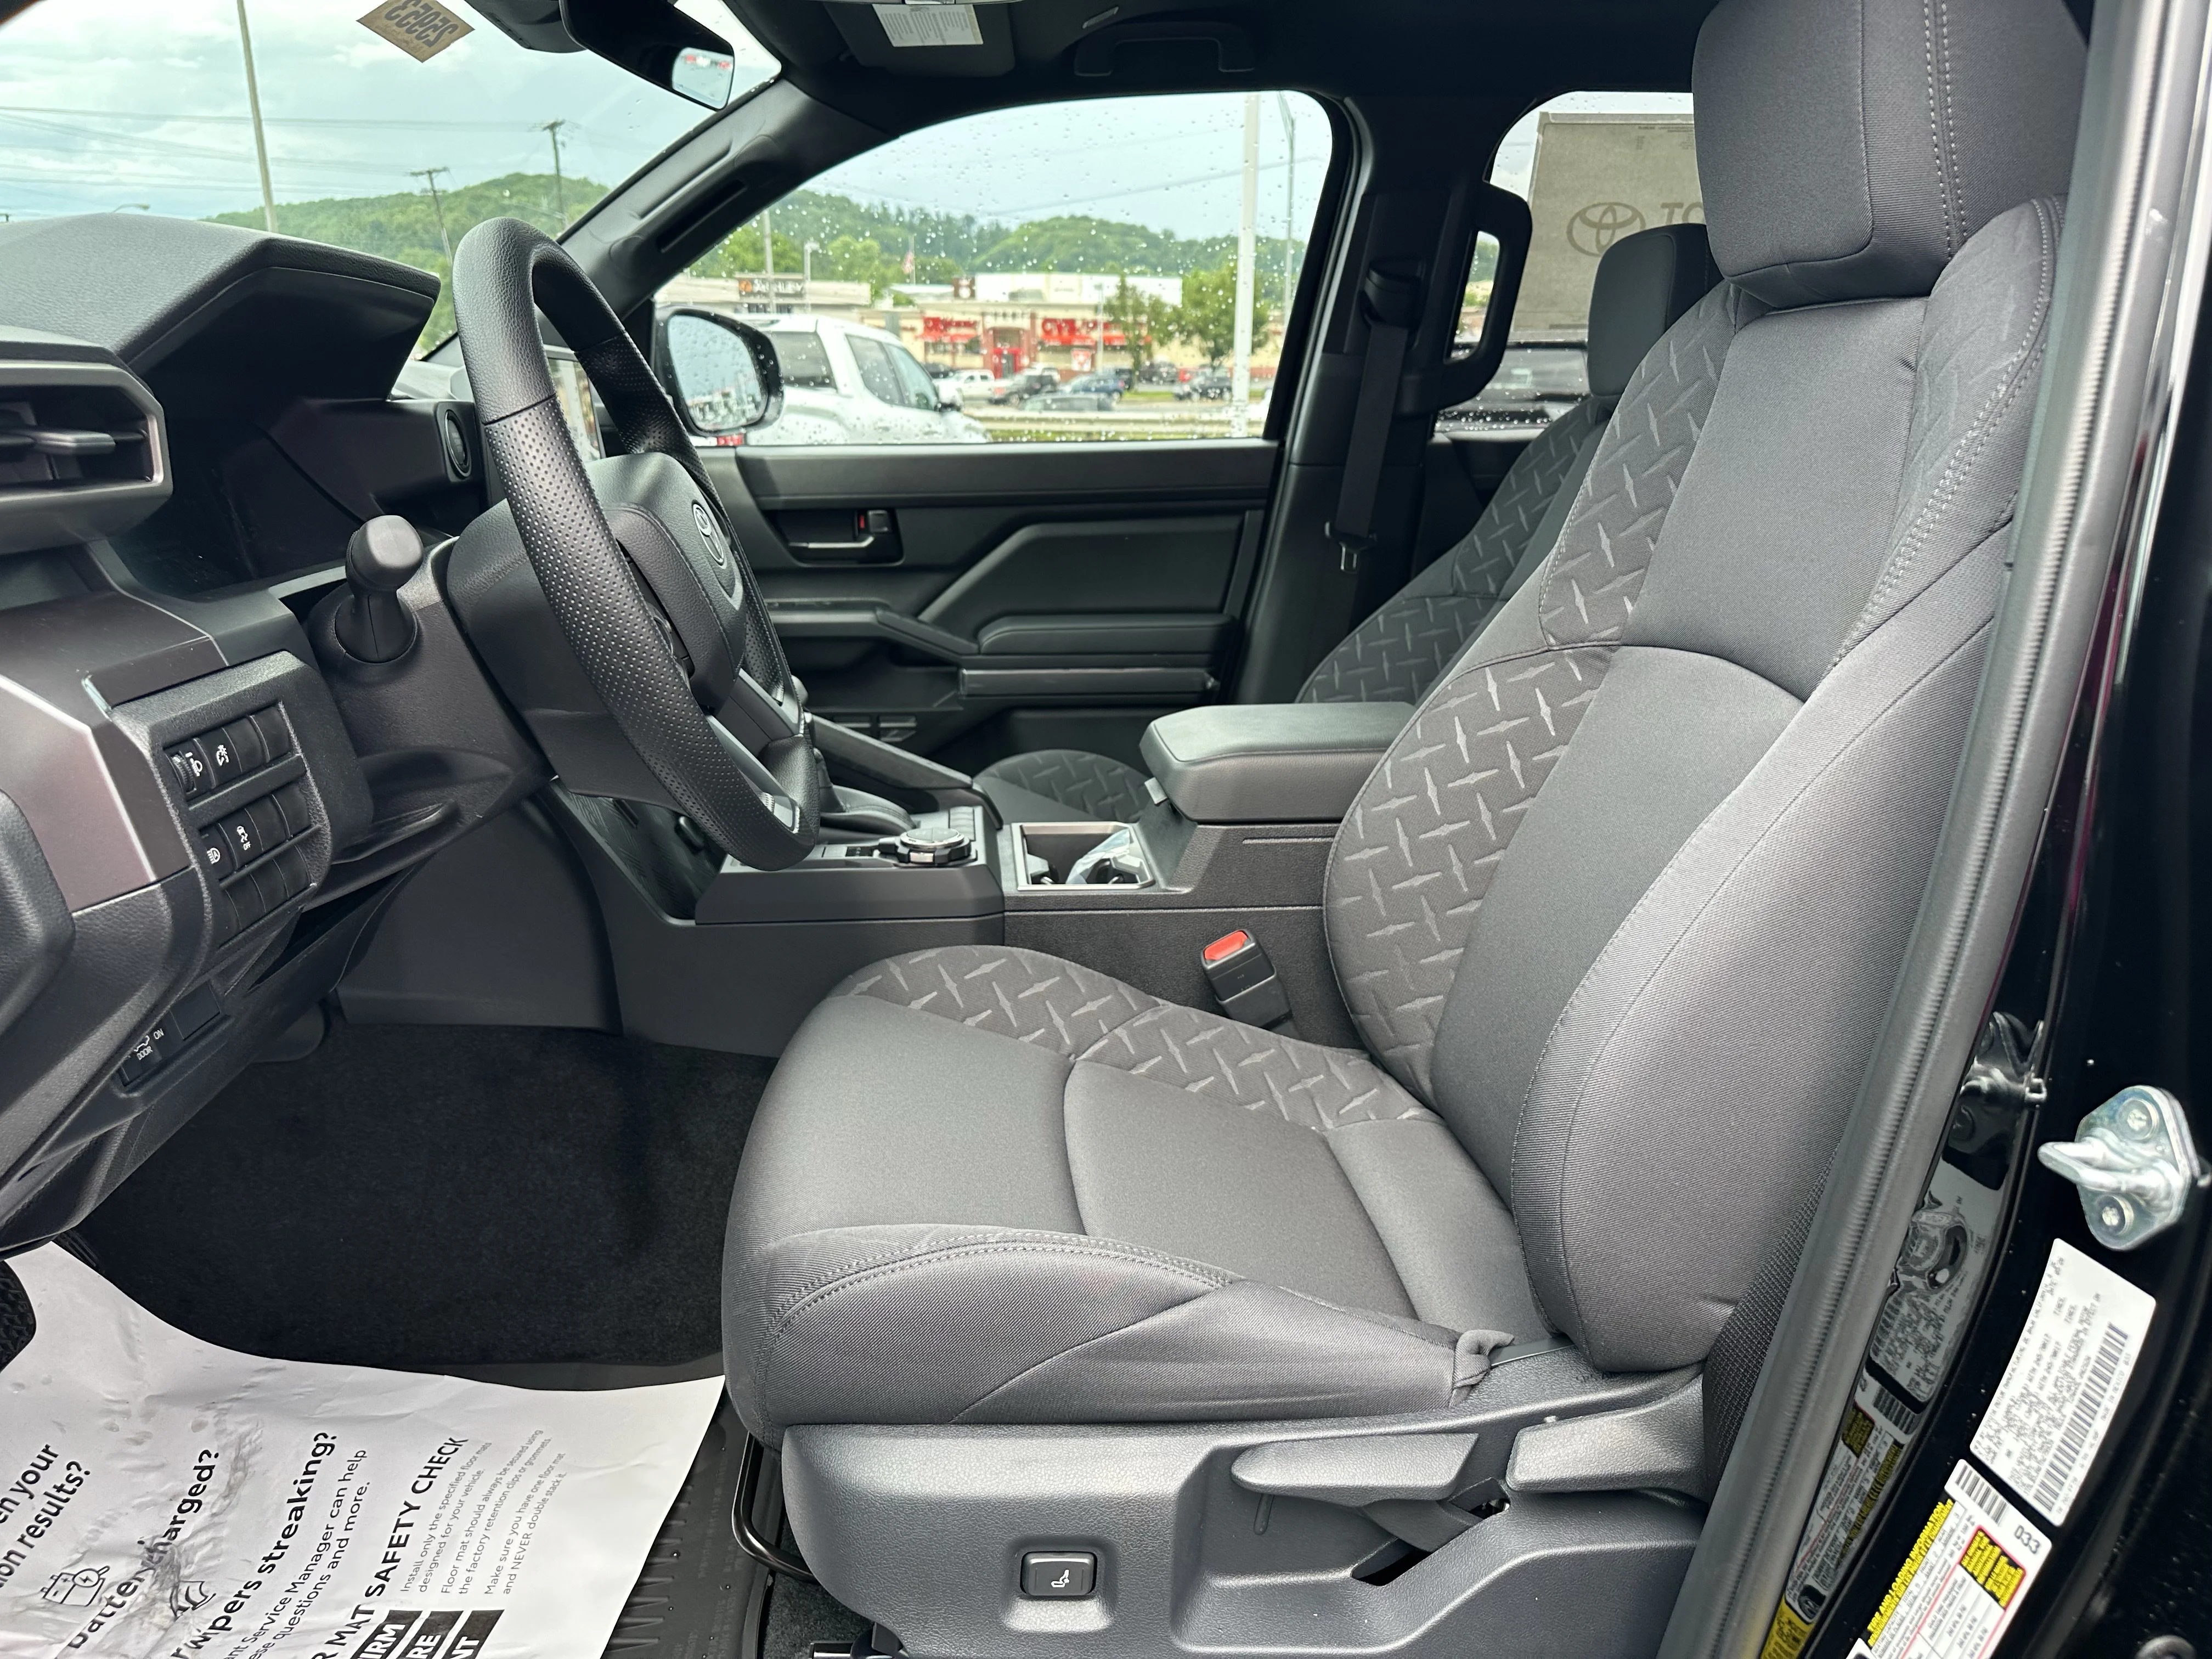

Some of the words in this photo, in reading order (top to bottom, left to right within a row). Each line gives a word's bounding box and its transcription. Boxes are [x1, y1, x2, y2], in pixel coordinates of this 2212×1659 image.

[136, 1046, 153, 1060] DOOR
[153, 1028, 164, 1040] ON
[9, 1444, 59, 1500] your
[16, 1460, 91, 1548] results?
[330, 1487, 348, 1519] can
[337, 1449, 368, 1482] help
[400, 1561, 424, 1592] Install
[420, 1534, 436, 1557] only
[429, 1513, 442, 1531] the
[439, 1471, 466, 1510] specified
[460, 1455, 478, 1470] floor
[476, 1442, 492, 1454] mats
[441, 1565, 459, 1593] Floor
[456, 1540, 469, 1561] mat
[465, 1504, 486, 1537] should
[482, 1476, 503, 1502] always
[496, 1468, 510, 1476] be
[507, 1446, 529, 1466] secured
[526, 1430, 544, 1444] using
[459, 1576, 472, 1594] the
[467, 1534, 490, 1572] factory
[484, 1491, 510, 1531] retention
[506, 1474, 522, 1489] clips
[524, 1437, 552, 1466] grommets.
[184, 1580, 262, 1650] wipers
[258, 1432, 337, 1574] streaking?
[273, 1574, 331, 1640] questions
[328, 1538, 349, 1569] and
[344, 1482, 370, 1531] more.
[285, 1523, 334, 1593] Manager
[324, 1604, 375, 1646] MAT
[364, 1500, 421, 1597] SAFETY
[411, 1437, 469, 1493] CHECK
[420, 1541, 446, 1592] designed
[441, 1522, 453, 1538] for
[449, 1499, 465, 1520] your
[461, 1469, 486, 1497] vehicle.
[484, 1565, 504, 1594] Make
[500, 1538, 514, 1562] sure
[509, 1516, 522, 1536] you
[519, 1494, 534, 1513] have
[531, 1480, 544, 1493] one
[538, 1465, 555, 1479] floor
[552, 1453, 566, 1464] mat
[503, 1573, 517, 1594] and
[511, 1532, 533, 1569] NEVER
[527, 1497, 549, 1530] double
[545, 1479, 562, 1496] stack
[1866, 1611, 1882, 1633] TIRE
[1877, 1593, 1892, 1615] AND
[1888, 1556, 1913, 1596] LOADING
[1909, 1501, 1944, 1559] INFORMATION
[1895, 1582, 1907, 1598] SUR
[1902, 1572, 1913, 1585] LES
[1908, 1553, 1923, 1575] PNEUS
[1928, 1498, 1955, 1540] CHARGEMENT
[2015, 1526, 2040, 1553] 033
[241, 1597, 292, 1643] Service
